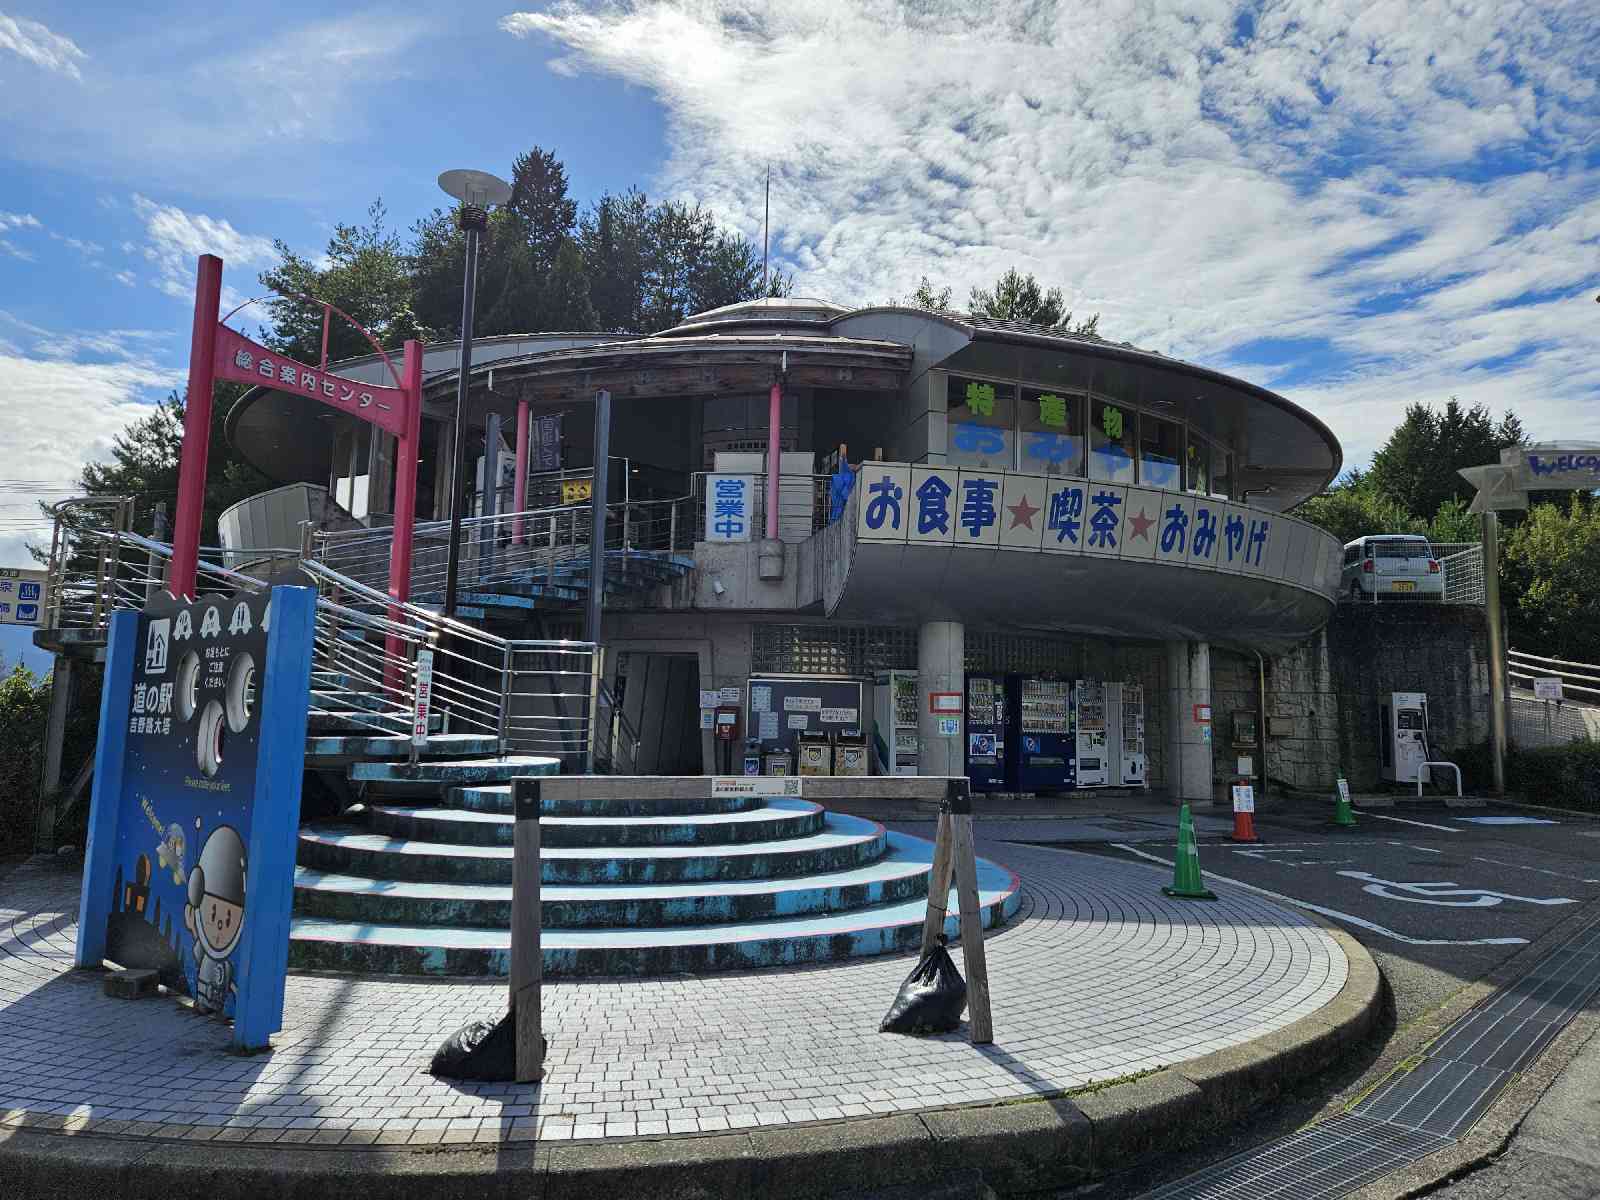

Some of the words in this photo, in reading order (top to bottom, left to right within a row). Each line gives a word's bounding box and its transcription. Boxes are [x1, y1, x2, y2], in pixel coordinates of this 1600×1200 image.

[235, 349, 391, 411] 総合案内センター
[714, 479, 745, 539] 営業中
[865, 475, 998, 537] お食事
[1048, 487, 1121, 548] 喫茶
[1160, 504, 1270, 566] おみやげ
[132, 682, 174, 714] 道の駅
